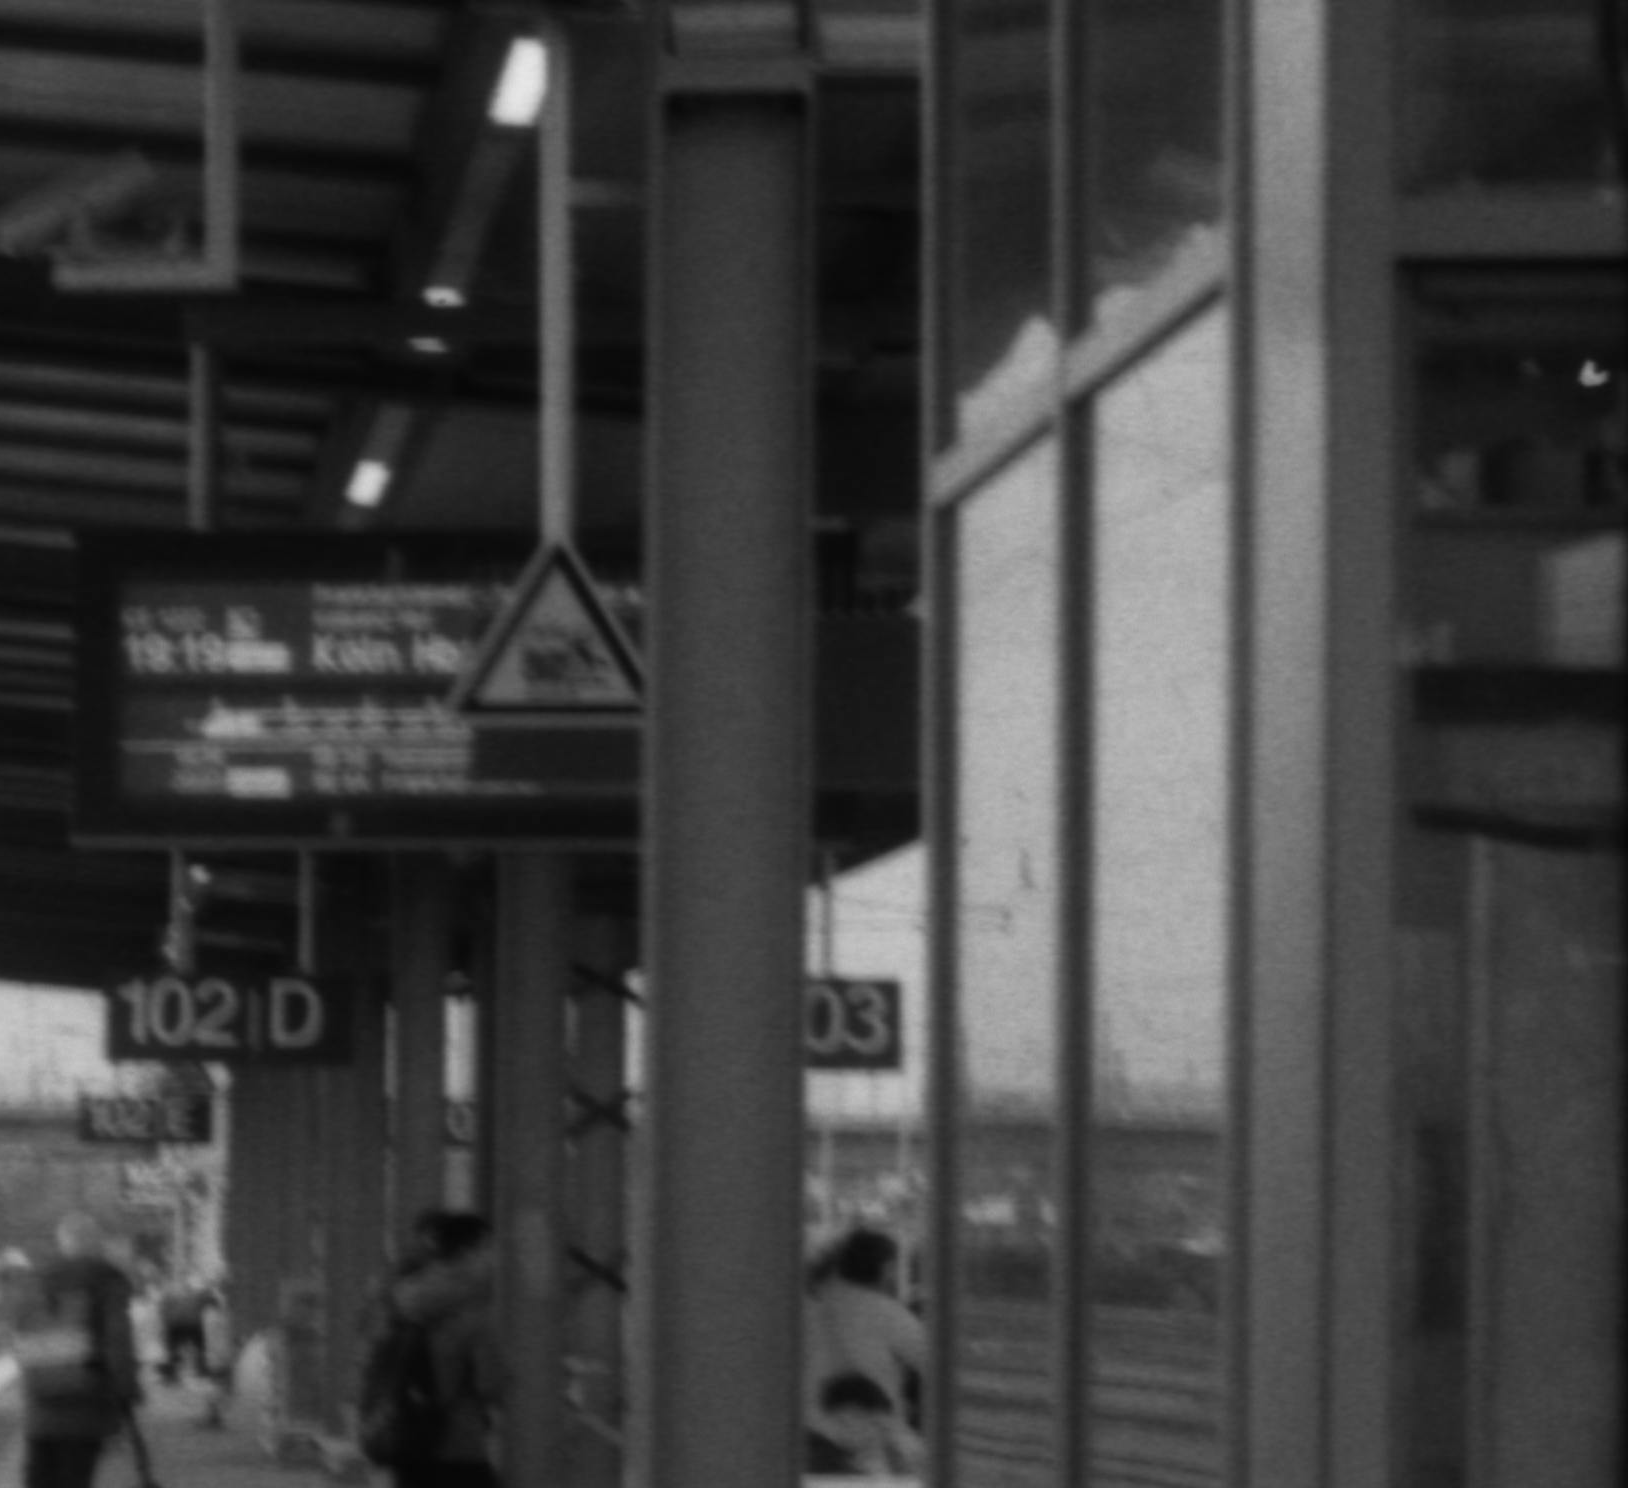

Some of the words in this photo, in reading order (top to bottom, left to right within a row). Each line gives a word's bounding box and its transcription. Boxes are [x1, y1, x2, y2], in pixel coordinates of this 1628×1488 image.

[117, 977, 239, 1048] 102
[270, 977, 324, 1049] D
[803, 984, 890, 1056] 03
